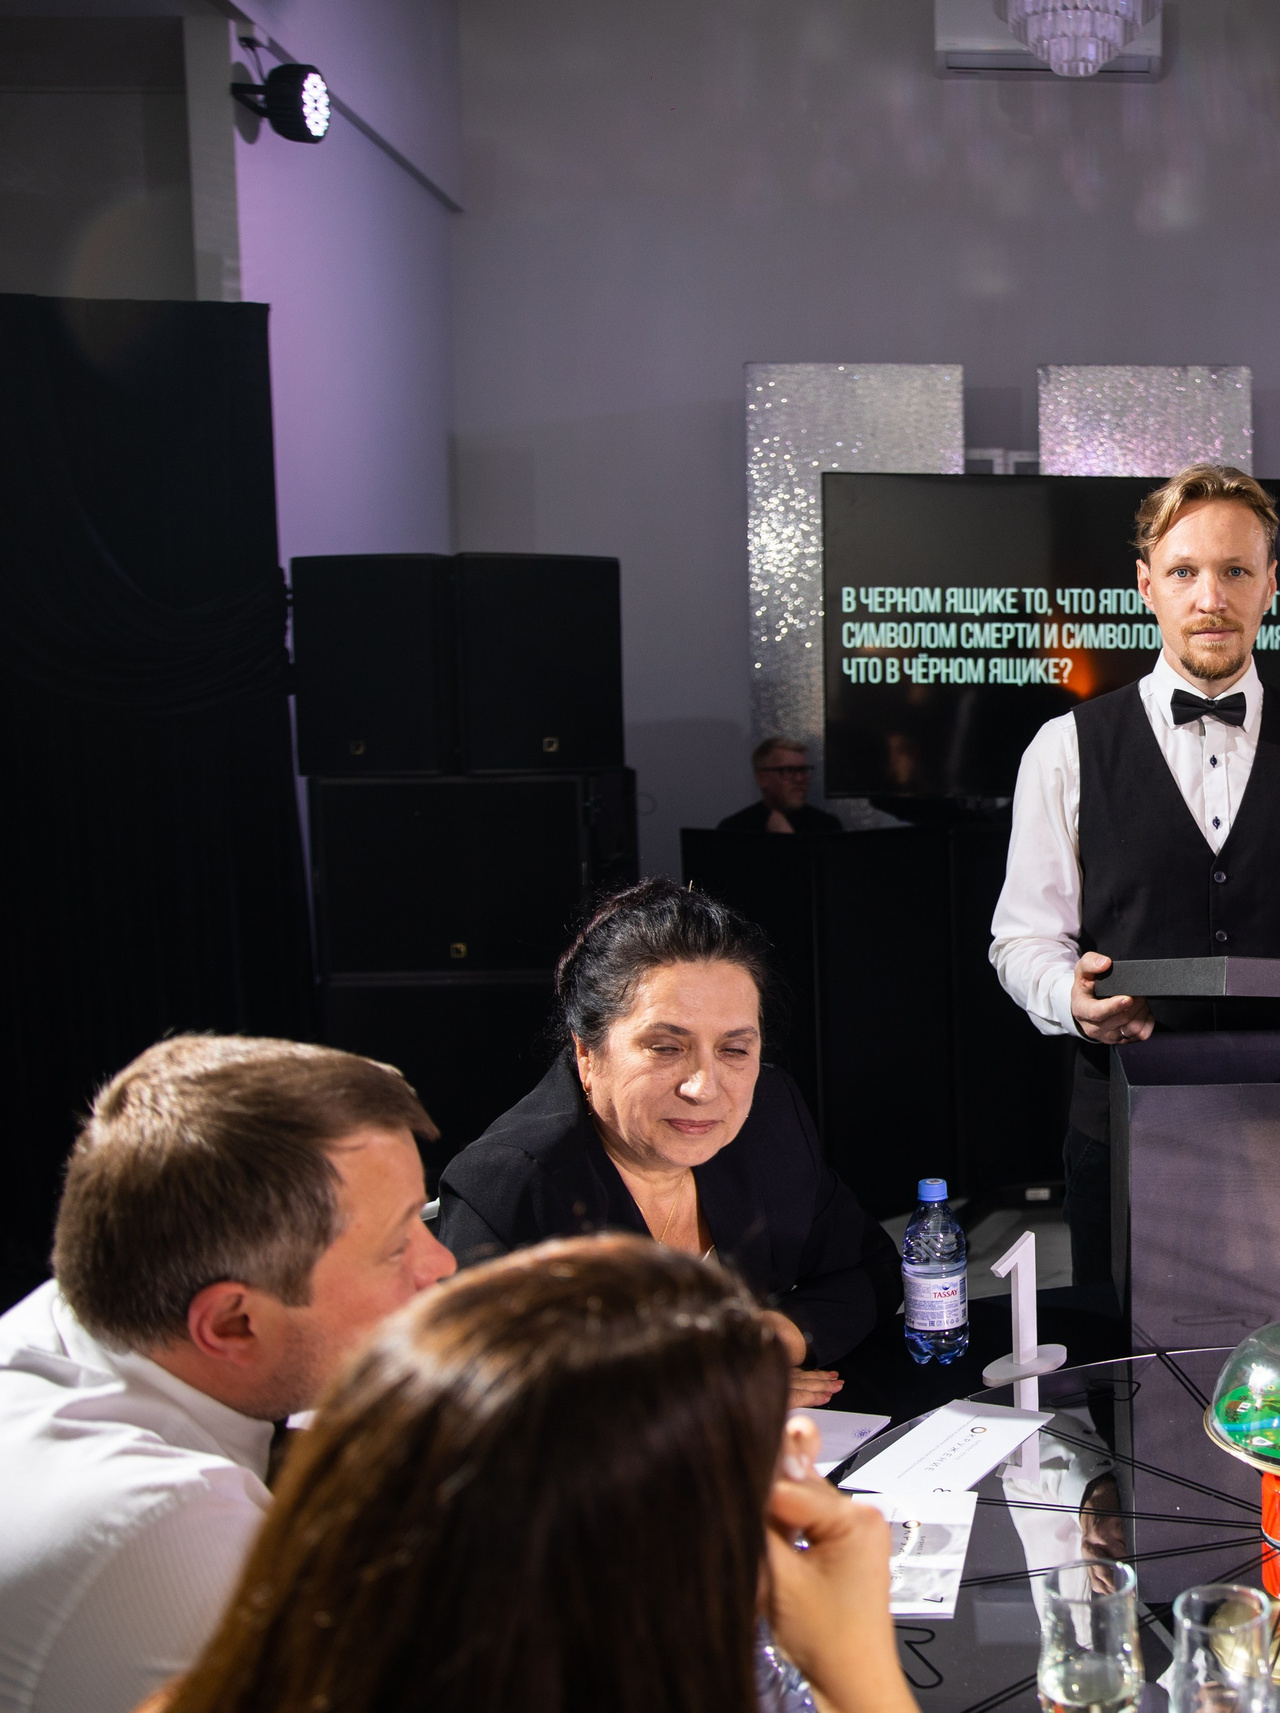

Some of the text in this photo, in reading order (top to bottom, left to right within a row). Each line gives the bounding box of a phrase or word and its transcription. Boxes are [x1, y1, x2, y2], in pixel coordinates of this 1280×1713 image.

[841, 586, 857, 614] В
[859, 586, 942, 614] ЧЕРНОМ
[945, 587, 1019, 616] ЯЩИКЕ
[1021, 587, 1053, 617] ТО,
[1056, 588, 1096, 615] ЧТО
[841, 622, 957, 649] СИМВОЛОМ
[960, 622, 1041, 649] СМЕРТИ
[1043, 623, 1059, 649] И
[842, 653, 1073, 687] ЧТО В ЧЁРНОМ ЯЩИКЕ?
[932, 1289, 959, 1299] TASSAY
[990, 1230, 1038, 1365] 1
